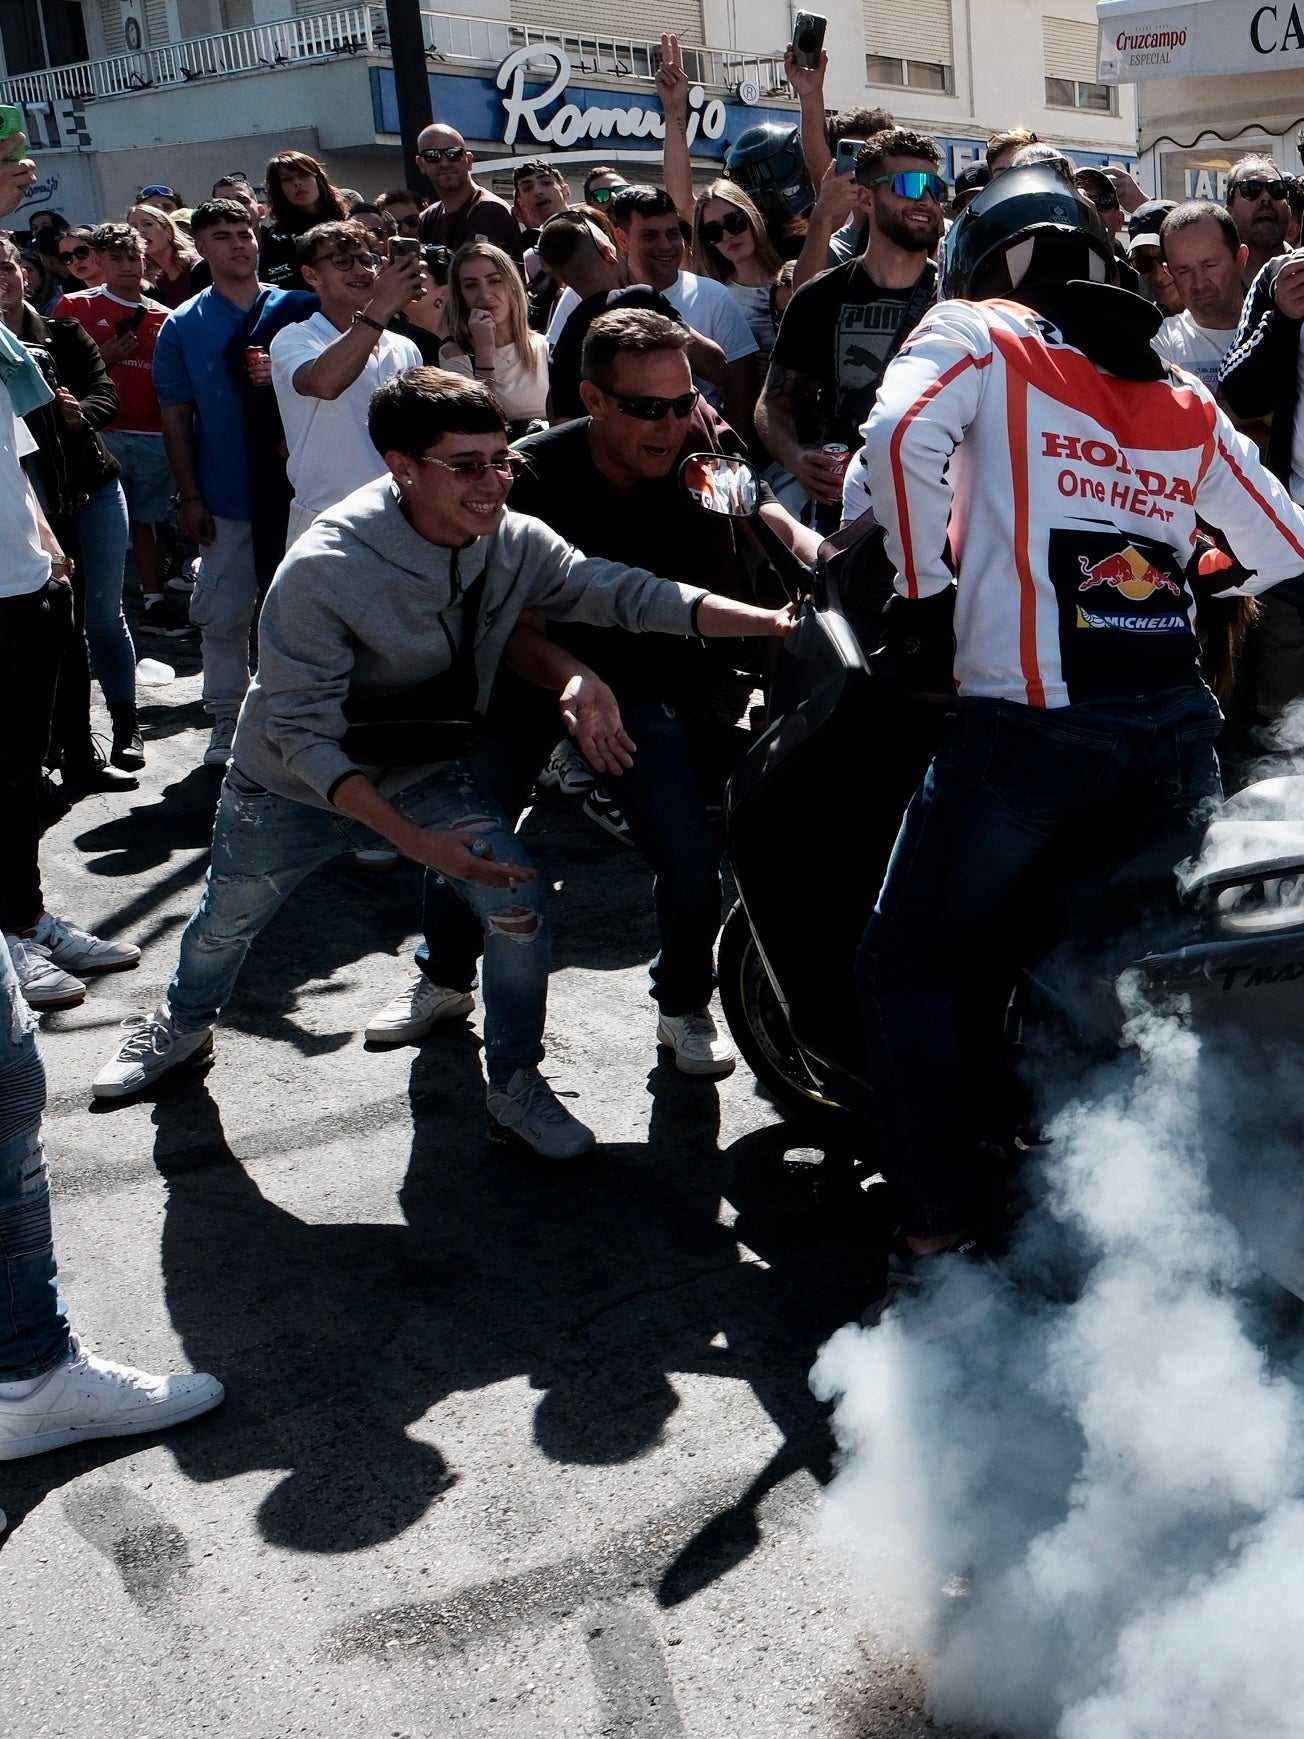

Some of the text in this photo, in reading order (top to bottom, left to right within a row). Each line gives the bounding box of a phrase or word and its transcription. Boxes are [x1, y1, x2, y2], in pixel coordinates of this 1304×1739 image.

[1116, 30, 1187, 51] Cruzcampo
[1130, 52, 1171, 66] ESPECIAL
[495, 43, 726, 163] Romerjo
[845, 305, 903, 330] PUM
[1058, 469, 1105, 502] One
[1104, 616, 1185, 629] MICHELIN
